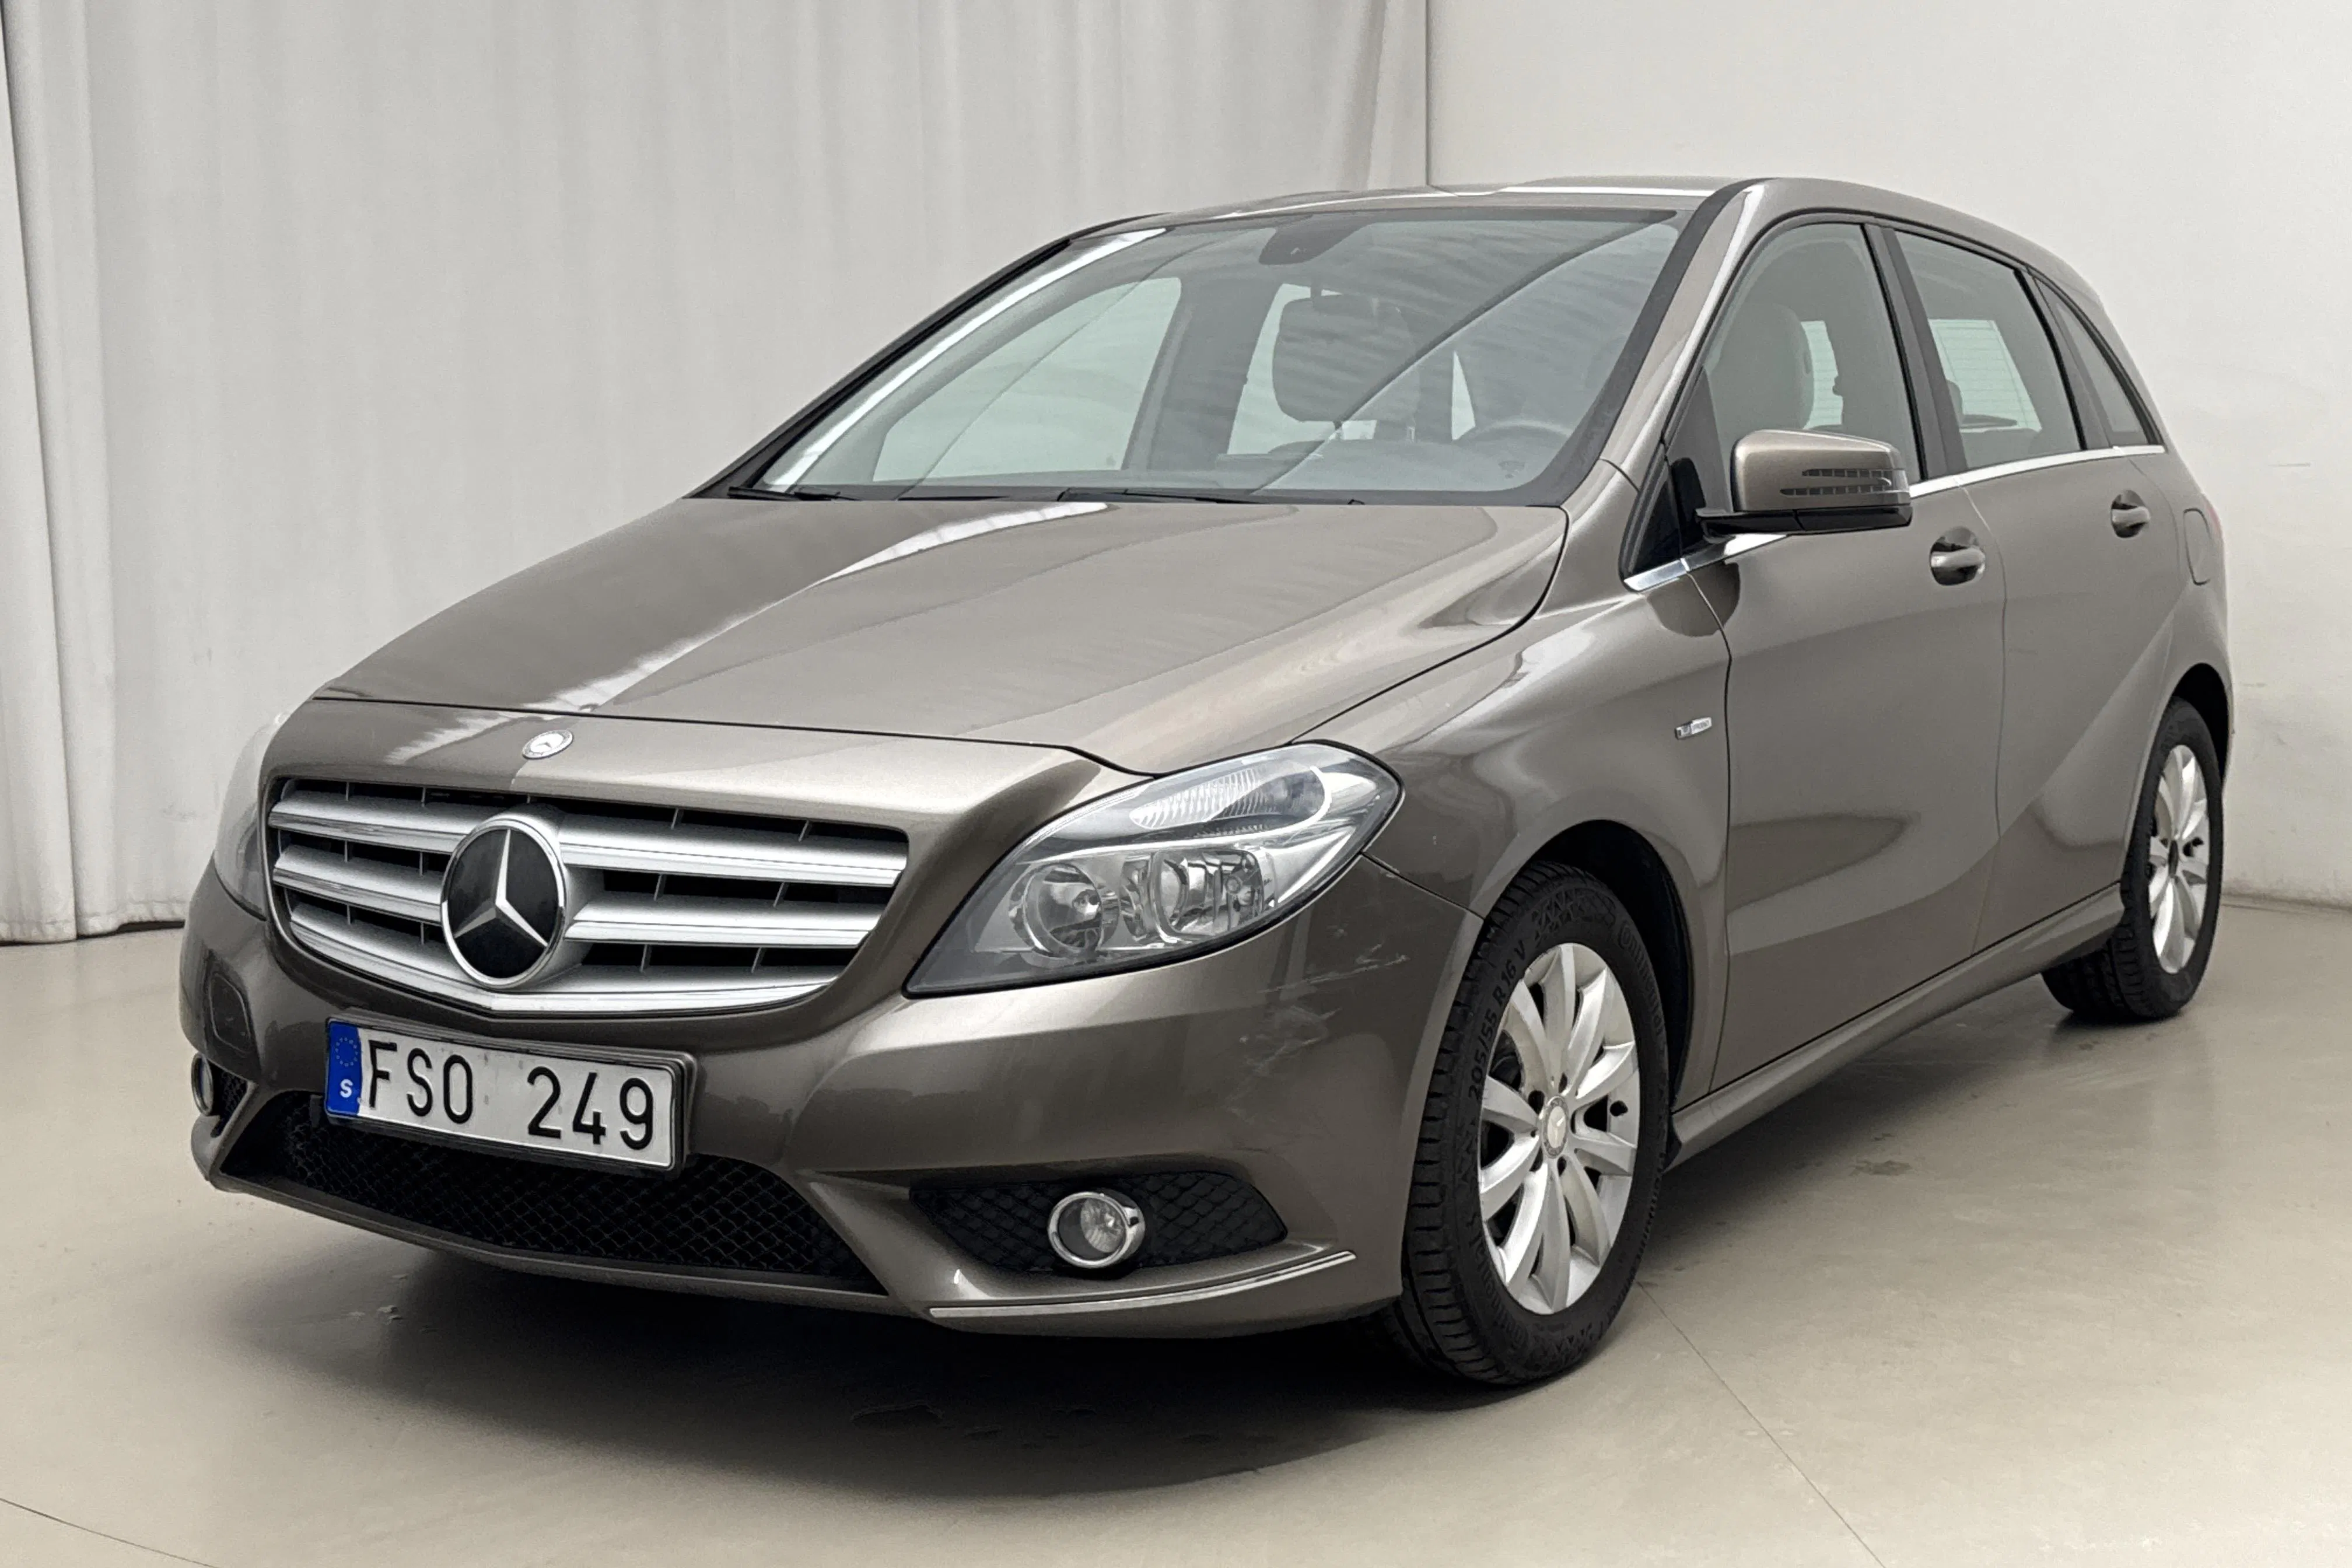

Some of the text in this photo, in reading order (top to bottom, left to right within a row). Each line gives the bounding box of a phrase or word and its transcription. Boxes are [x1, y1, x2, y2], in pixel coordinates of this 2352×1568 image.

[338, 1078, 354, 1098] S
[368, 1039, 654, 1150] FSO 249
[1469, 1009, 1497, 1101] 205/55
